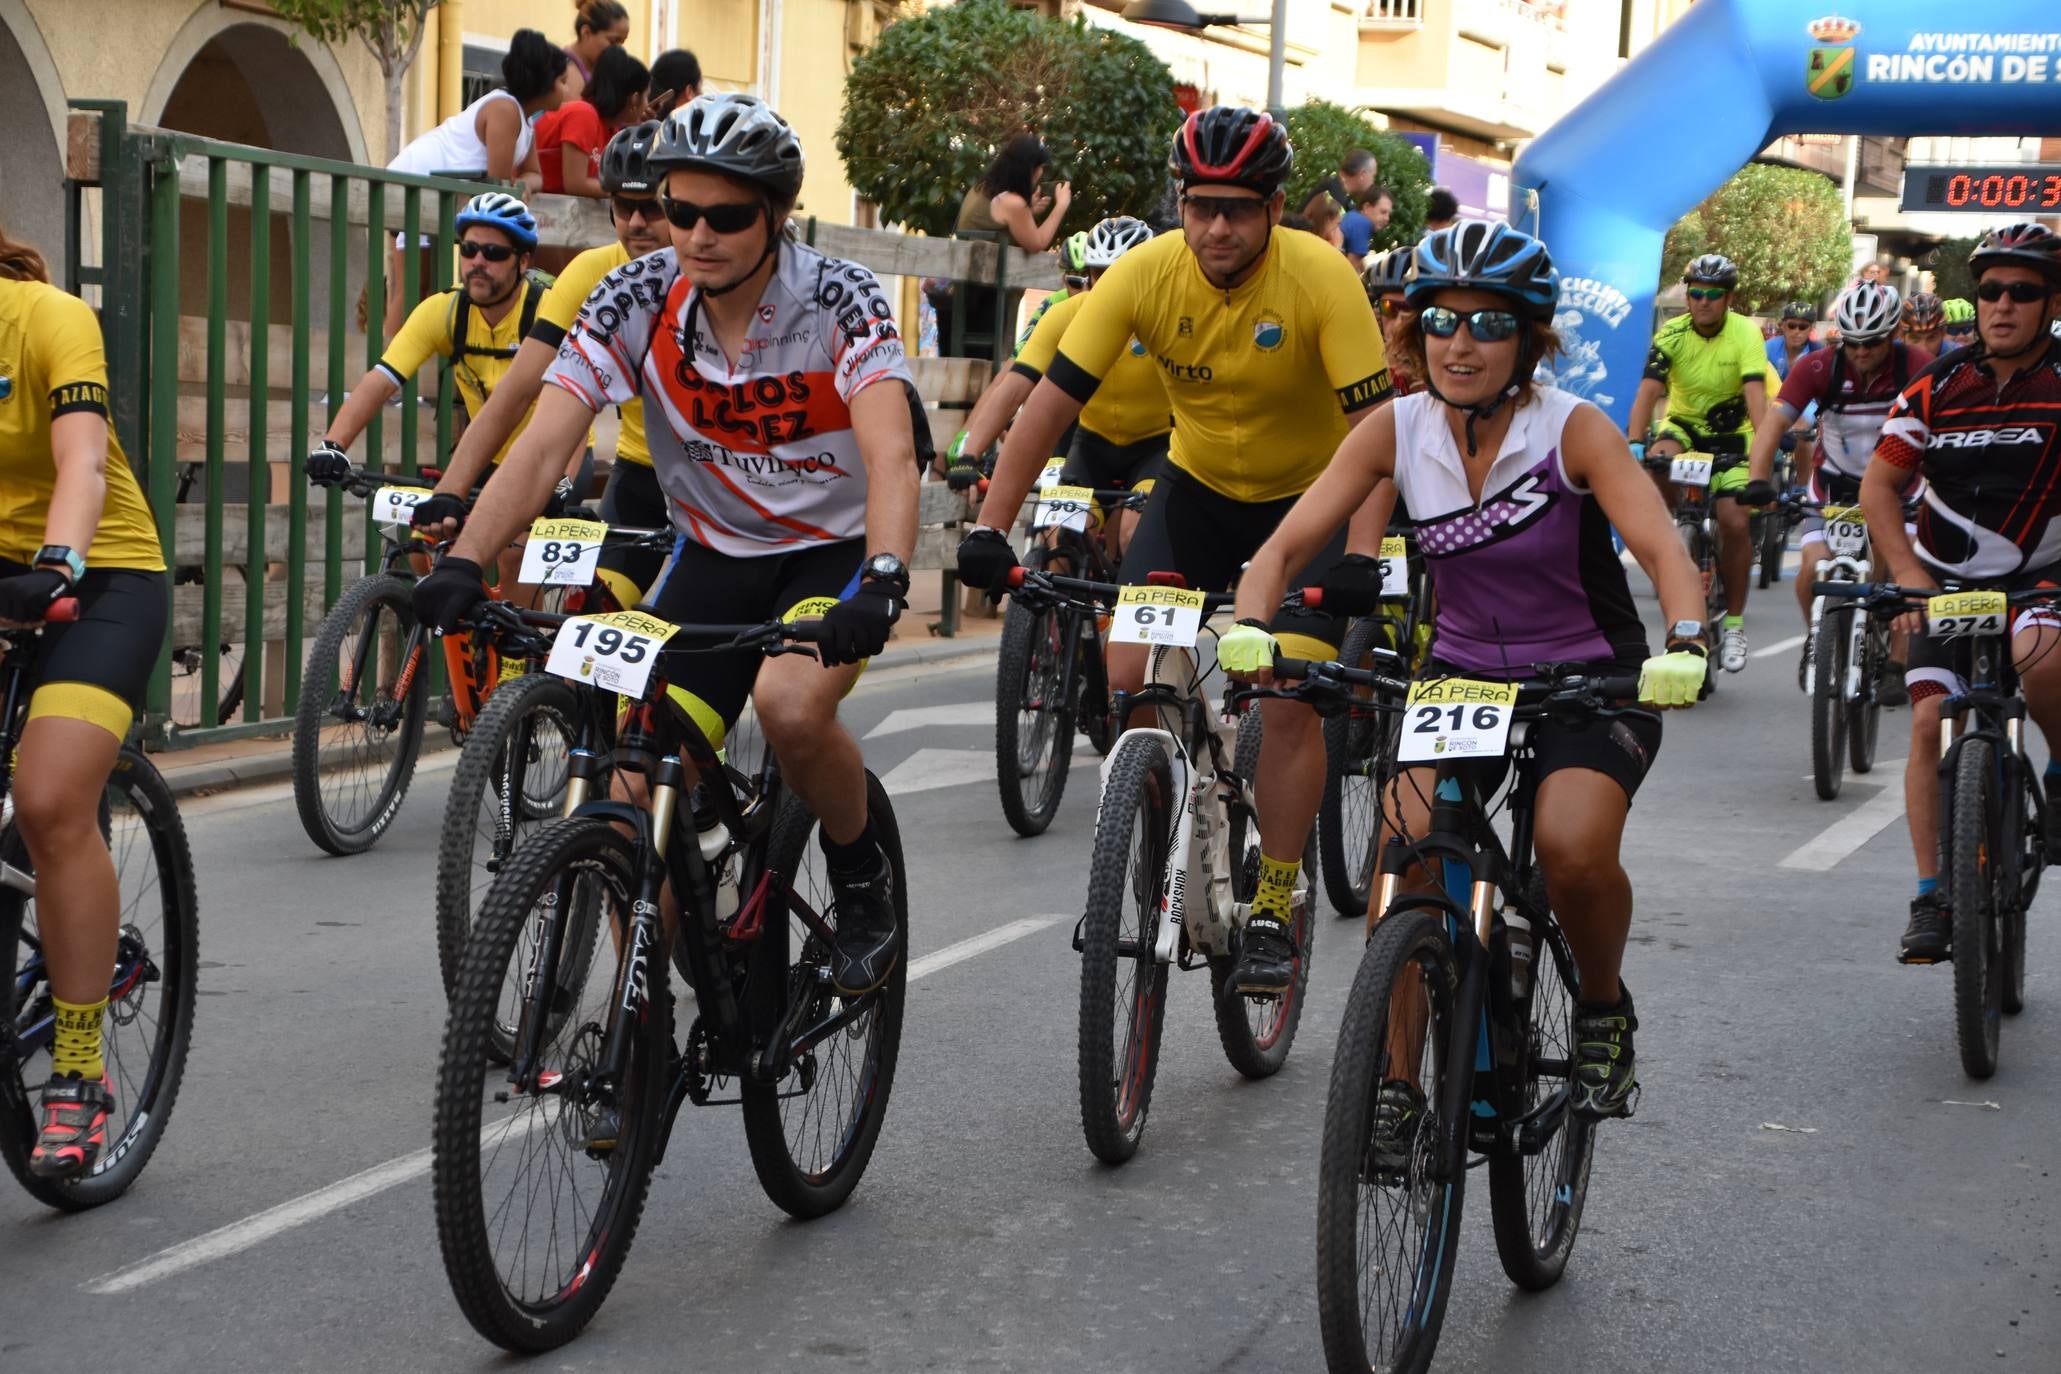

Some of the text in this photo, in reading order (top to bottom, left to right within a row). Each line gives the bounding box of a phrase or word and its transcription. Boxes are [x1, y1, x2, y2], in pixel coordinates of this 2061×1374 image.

[1866, 53, 1993, 82] RINCÓN
[2002, 55, 2047, 82] DE
[586, 277, 668, 346] LOPEZ
[389, 492, 419, 507] 62
[534, 525, 601, 538] LA PERA
[1829, 523, 1865, 538] 103
[542, 541, 582, 563] 83
[1380, 543, 1403, 553] ERA
[1123, 592, 1199, 606] LA PERA
[1933, 598, 2003, 613] LA PERA
[795, 601, 833, 617] RINC
[1134, 606, 1176, 626] 61
[612, 613, 669, 637] PERA
[1938, 616, 1999, 634] 274
[574, 623, 652, 664] 195
[1413, 686, 1510, 702] LA PERA
[1413, 705, 1501, 733] 216
[371, 789, 402, 835] MAXXIS
[1170, 869, 1187, 925] ROCKSHOX
[1251, 919, 1280, 930] LUCK
